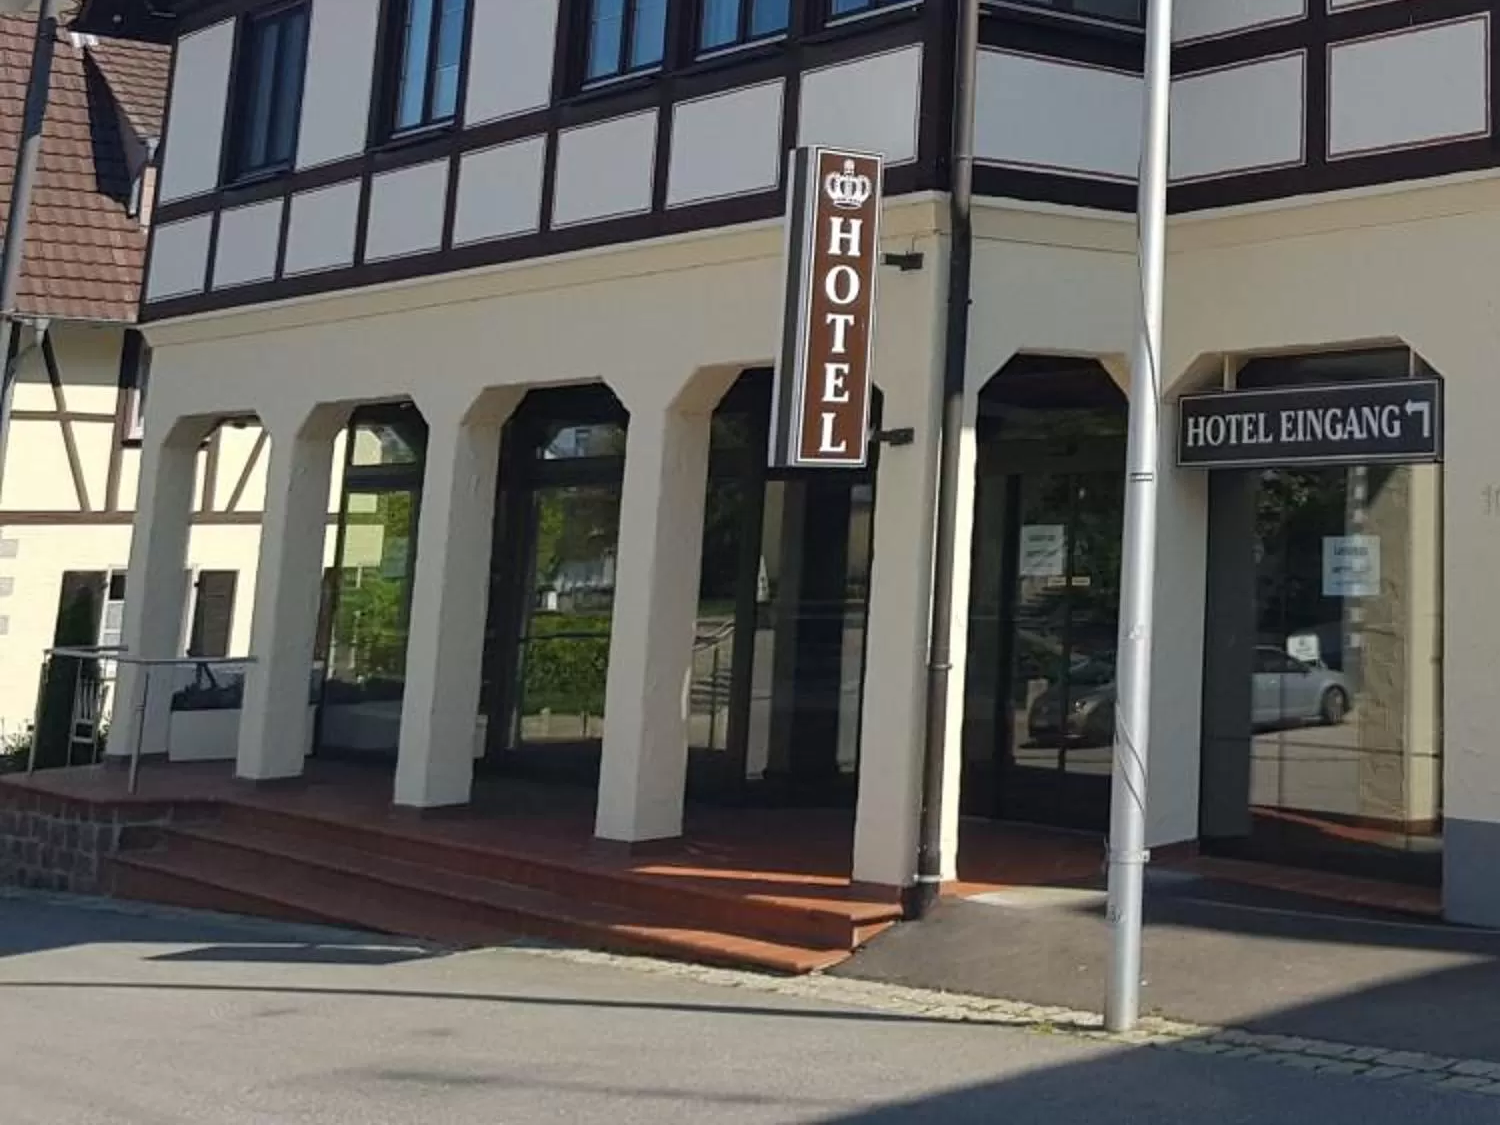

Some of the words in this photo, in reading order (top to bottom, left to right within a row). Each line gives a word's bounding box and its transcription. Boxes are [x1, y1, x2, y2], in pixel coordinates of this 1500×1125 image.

[819, 216, 863, 453] HOTEL
[1186, 412, 1273, 447] HOTEL
[1280, 405, 1401, 442] EINGANG
